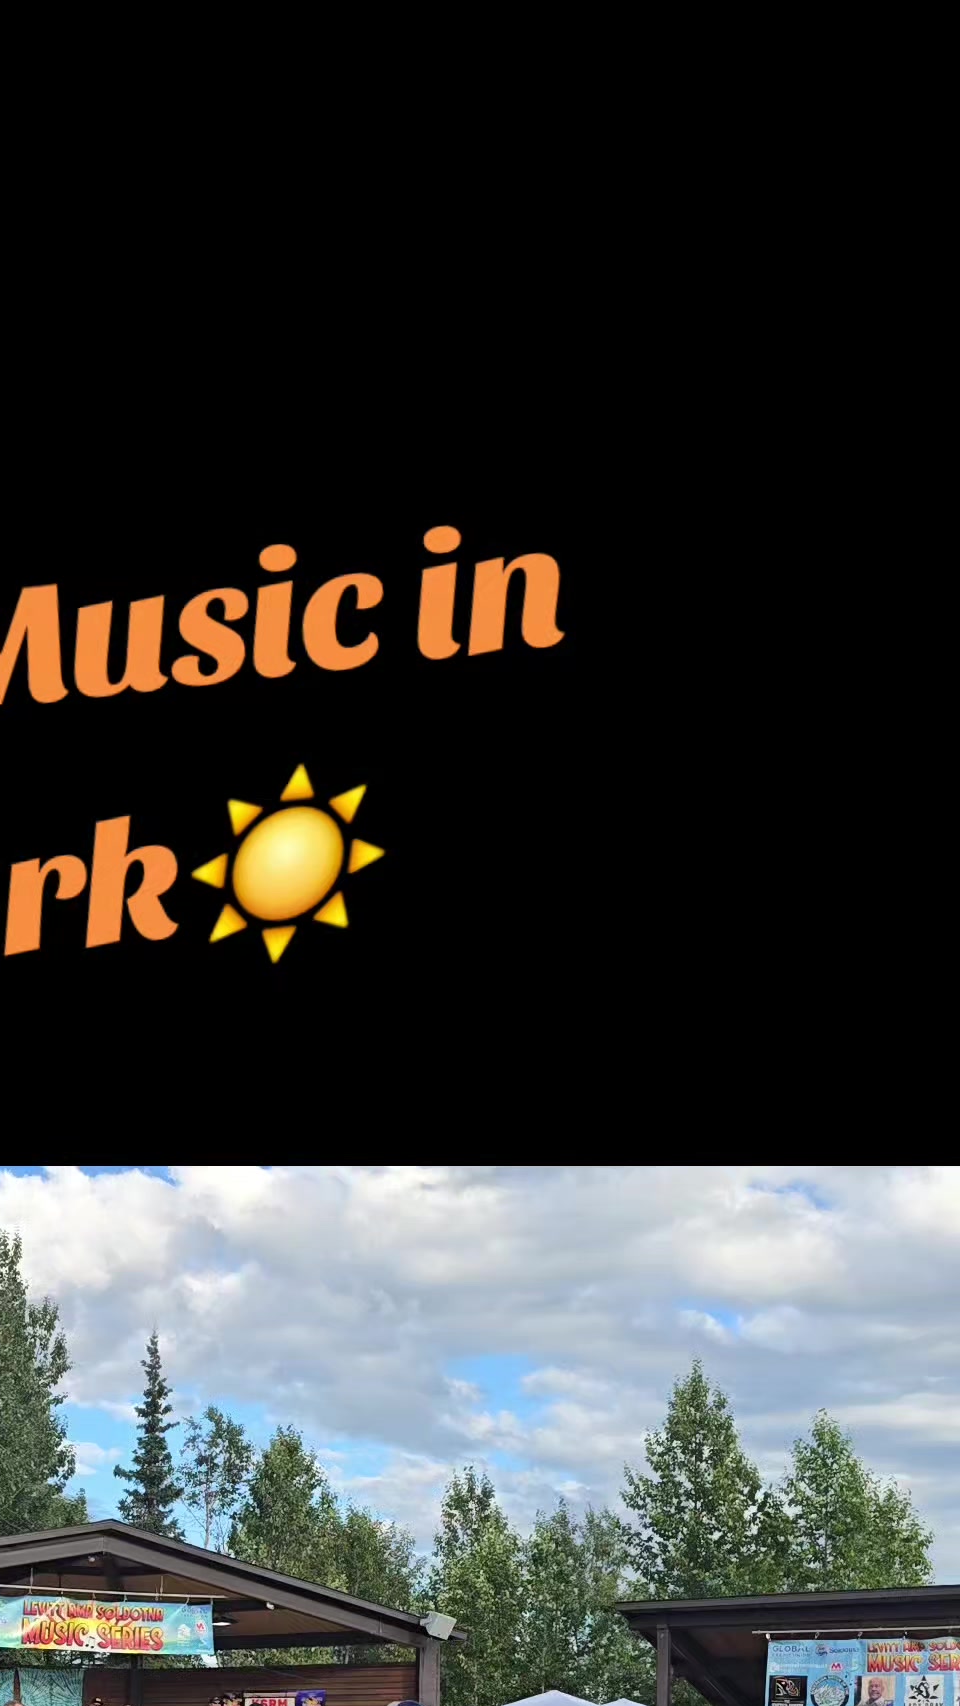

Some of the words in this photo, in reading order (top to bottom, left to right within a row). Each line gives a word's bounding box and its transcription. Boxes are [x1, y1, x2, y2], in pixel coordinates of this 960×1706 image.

[96, 1606, 164, 1622] SOLDOTNA
[22, 1618, 89, 1647] MUSIC
[97, 1623, 164, 1651] SERIES
[867, 1652, 922, 1673] MUSIC
